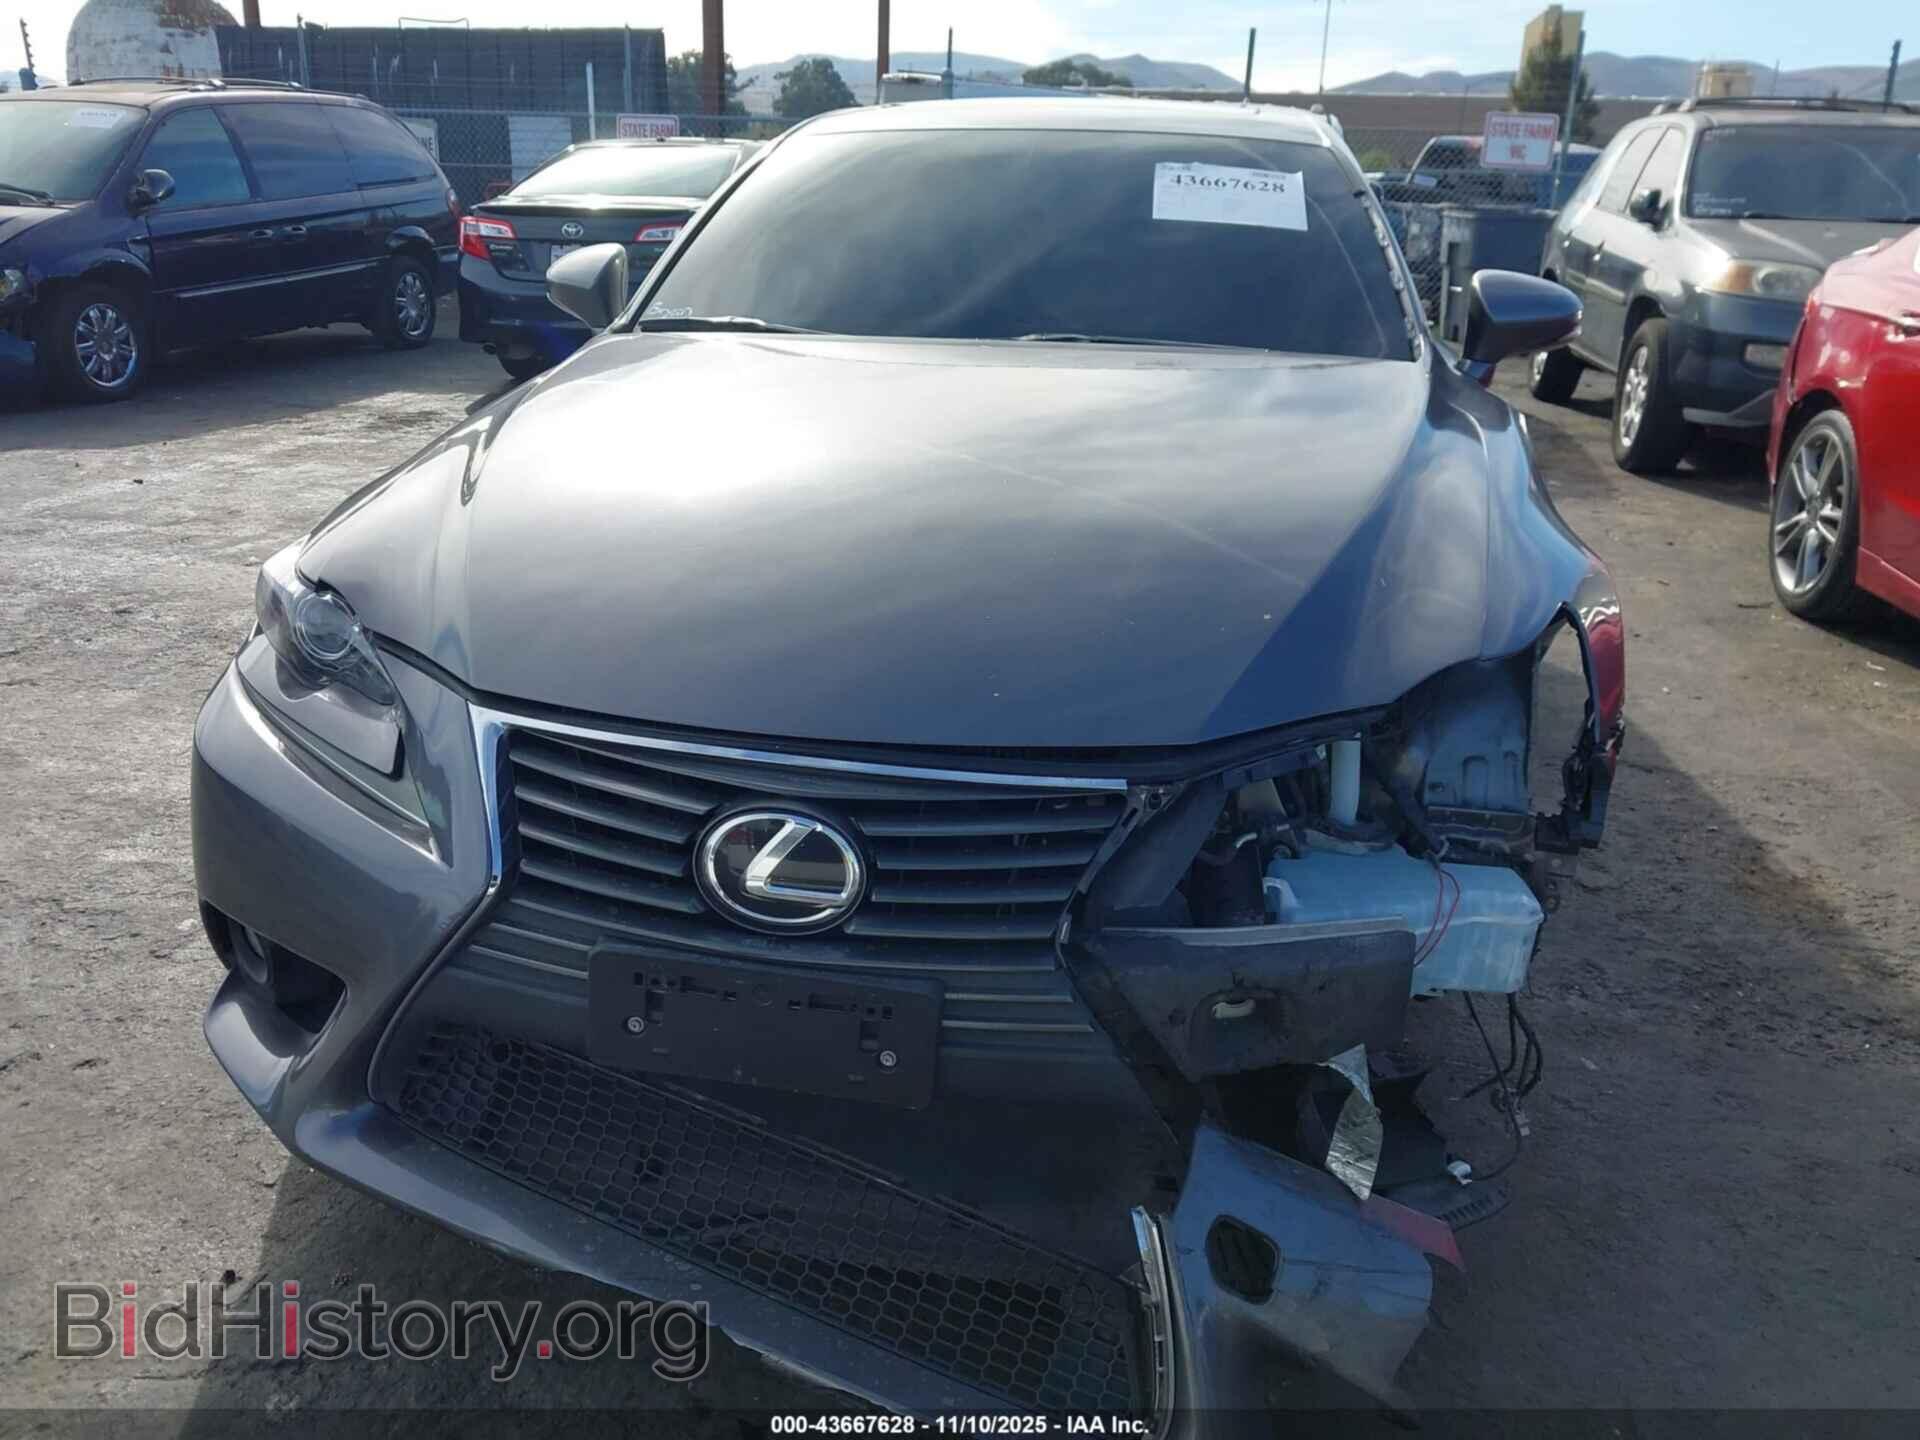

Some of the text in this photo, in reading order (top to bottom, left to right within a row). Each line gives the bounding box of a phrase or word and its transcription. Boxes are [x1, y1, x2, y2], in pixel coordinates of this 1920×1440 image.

[622, 122, 675, 138] STATE FARM
[1489, 121, 1553, 140] STATE FARM
[1169, 174, 1286, 193] 43667628
